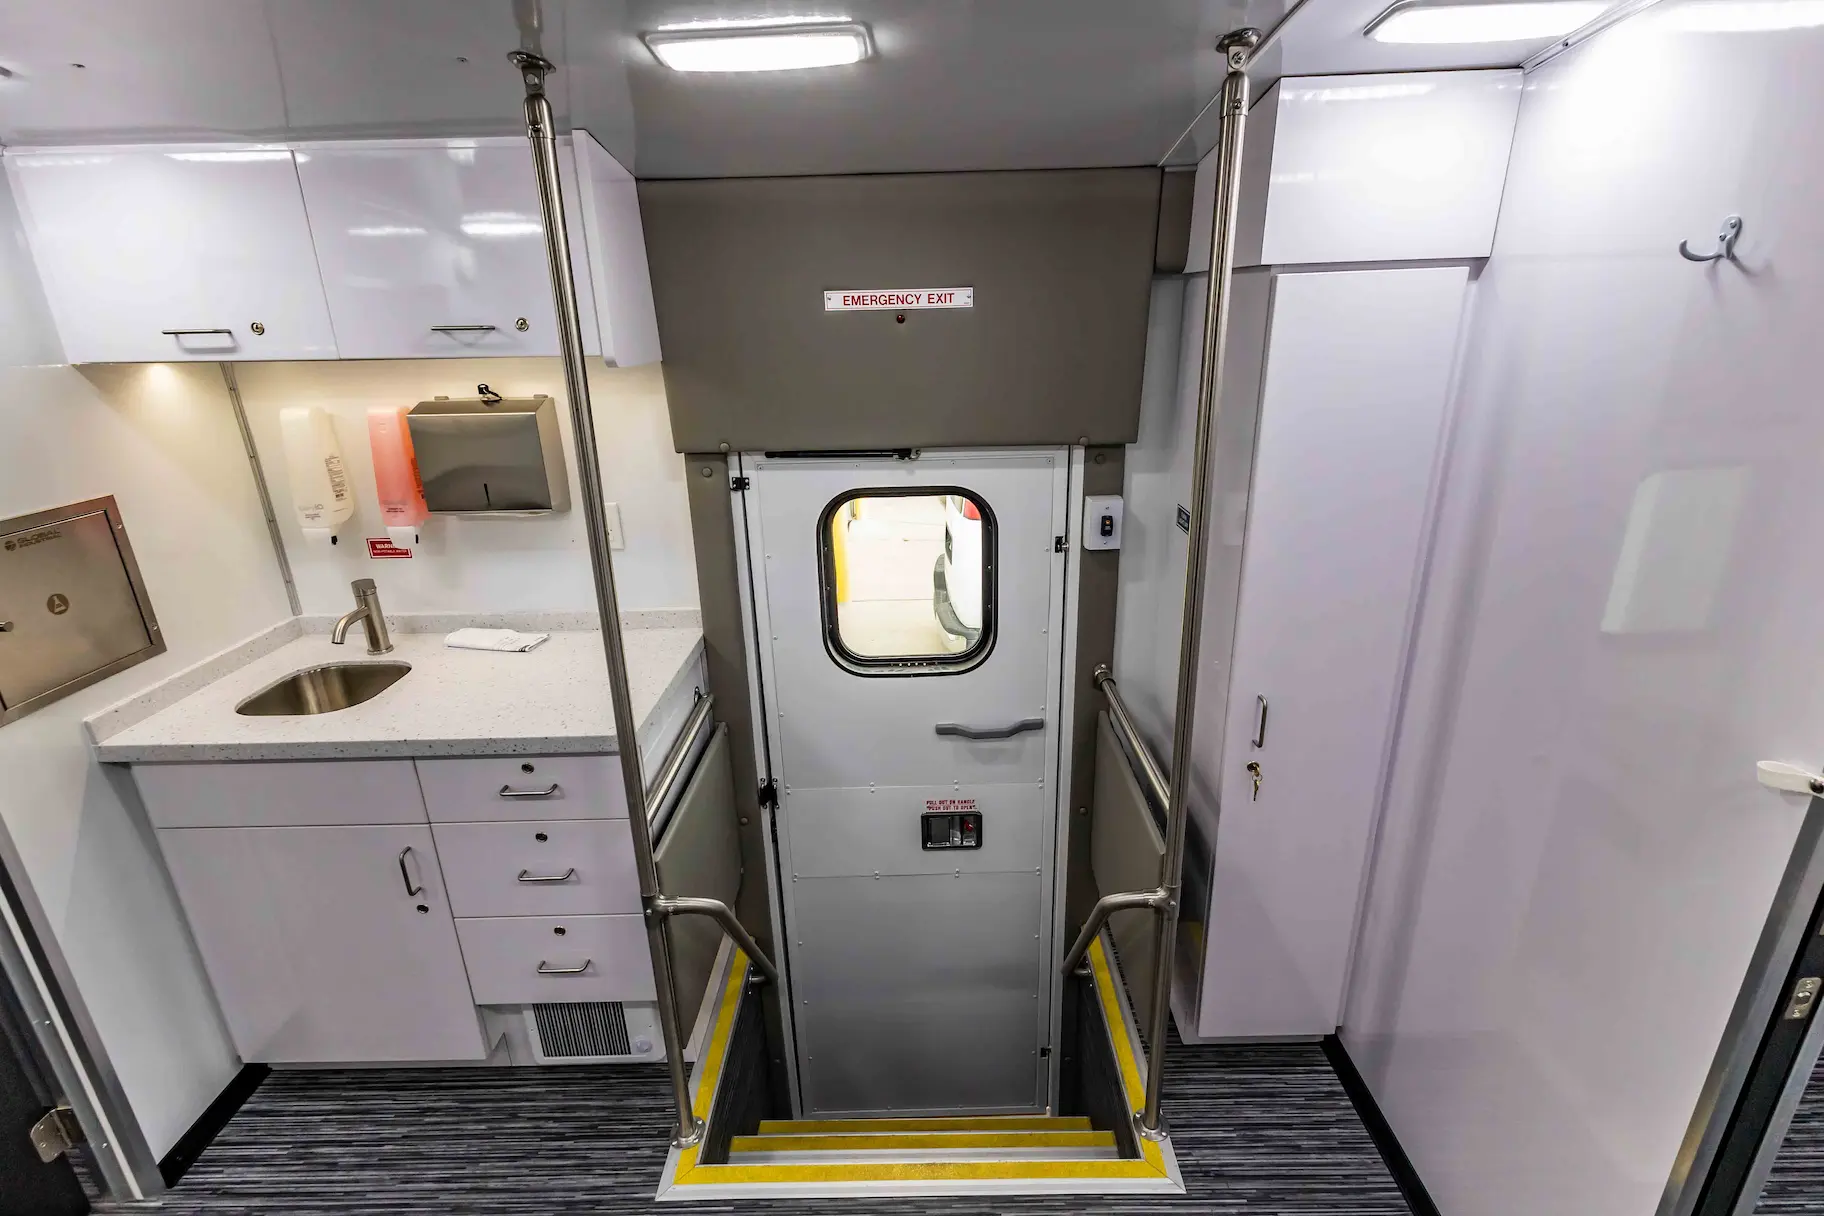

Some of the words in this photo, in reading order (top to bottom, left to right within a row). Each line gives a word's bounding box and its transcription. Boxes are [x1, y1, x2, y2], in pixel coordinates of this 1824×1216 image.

[843, 293, 922, 306] EMERGENCY
[927, 292, 955, 304] EXIT
[17, 528, 61, 544] GLOBAL
